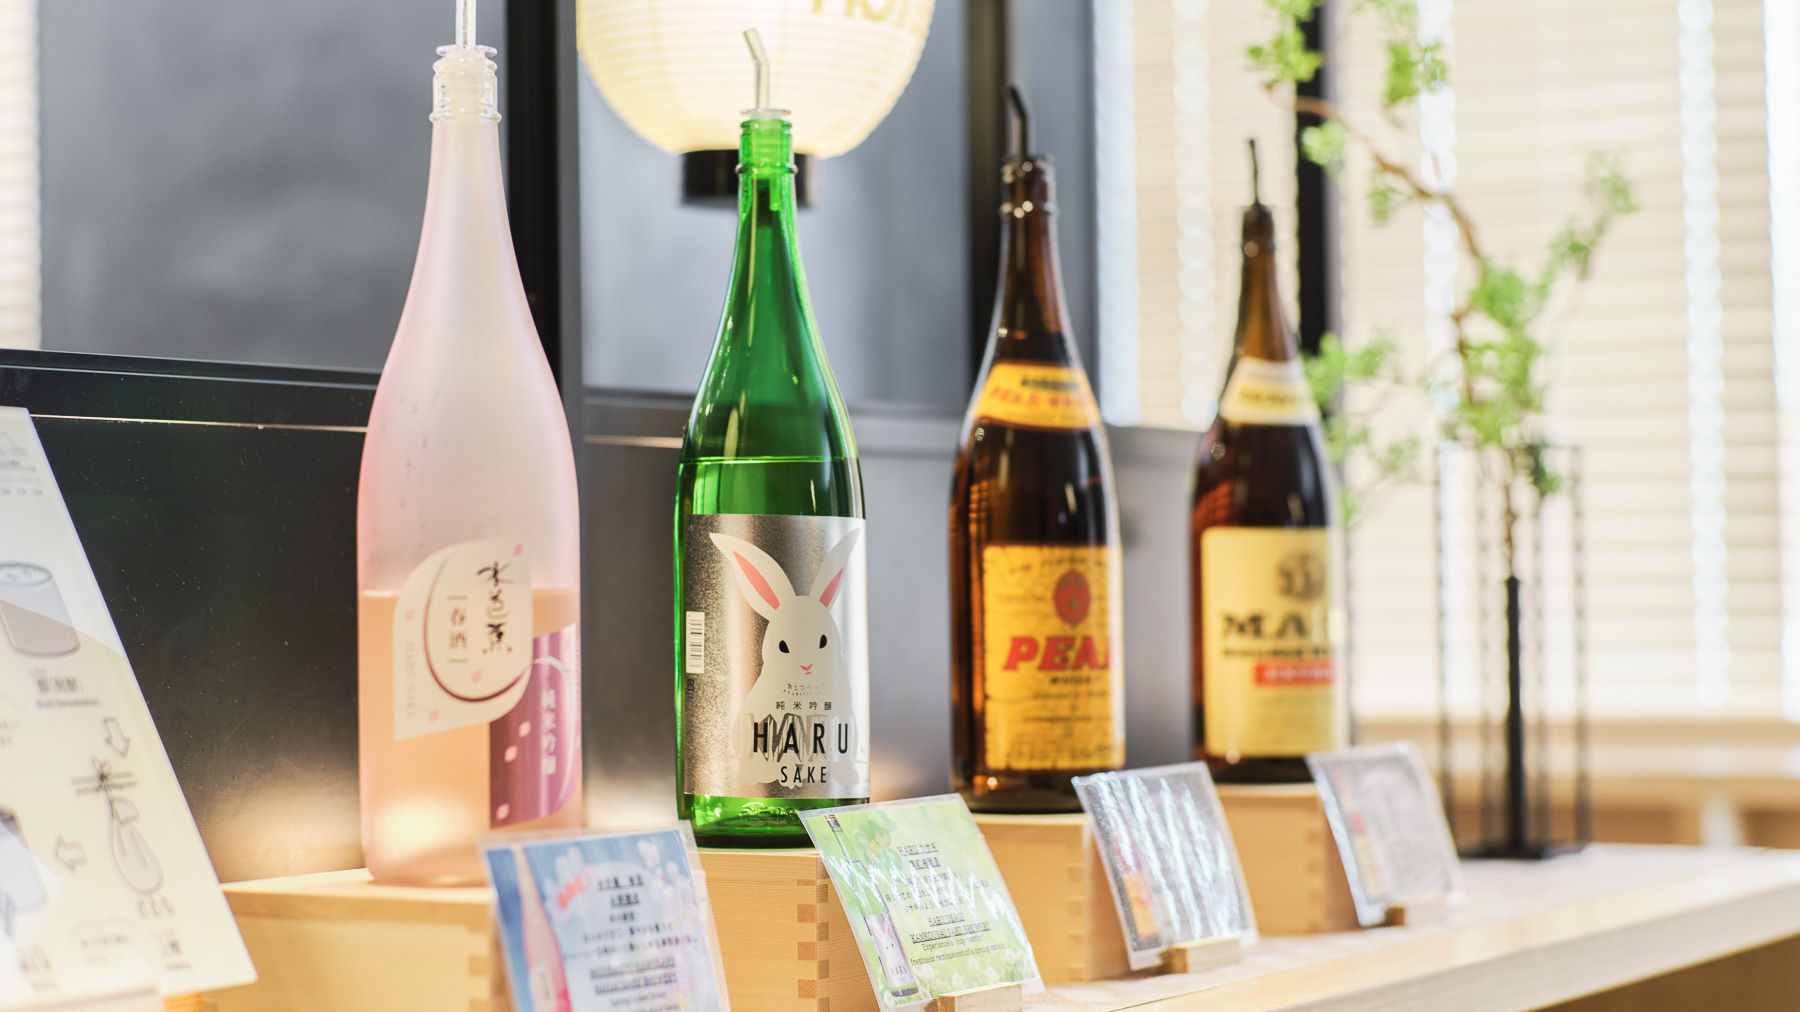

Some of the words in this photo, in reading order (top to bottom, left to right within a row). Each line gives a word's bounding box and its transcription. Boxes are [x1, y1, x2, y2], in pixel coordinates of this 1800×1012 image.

[1002, 636, 1112, 671] PEA
[776, 701, 832, 711] 純米吟醸
[753, 722, 848, 754] HARU
[780, 765, 827, 783] SAKE
